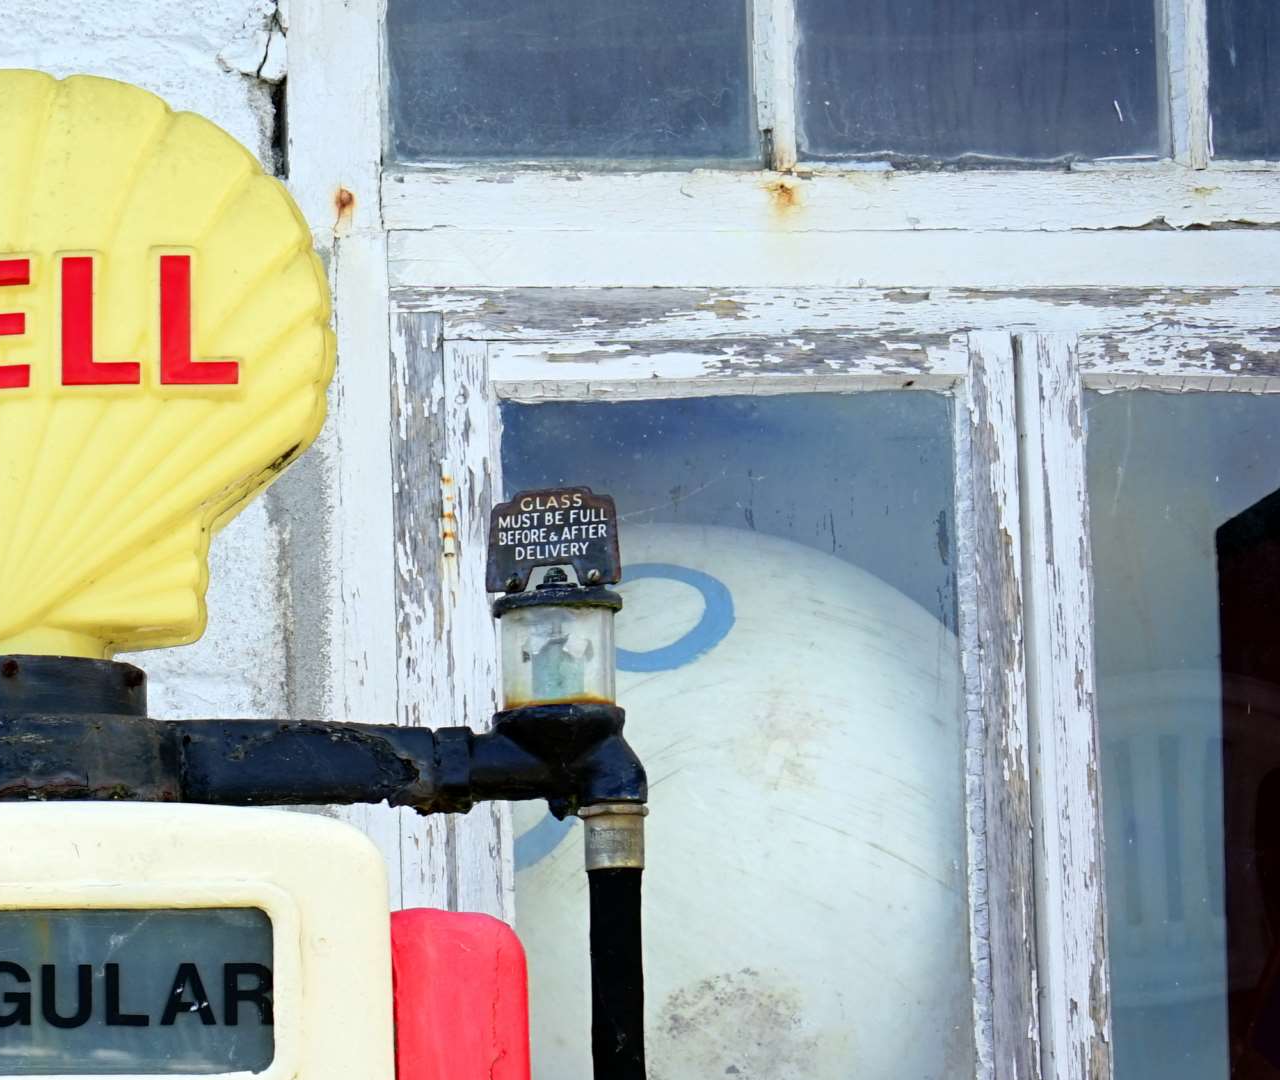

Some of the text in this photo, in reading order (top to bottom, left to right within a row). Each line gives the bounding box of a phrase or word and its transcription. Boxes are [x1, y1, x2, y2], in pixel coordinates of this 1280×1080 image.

[520, 493, 582, 511] GLASS
[498, 507, 608, 529] MUST BE FULL
[498, 523, 607, 546] BEFORE & AFTER
[515, 541, 589, 560] DELIVERY
